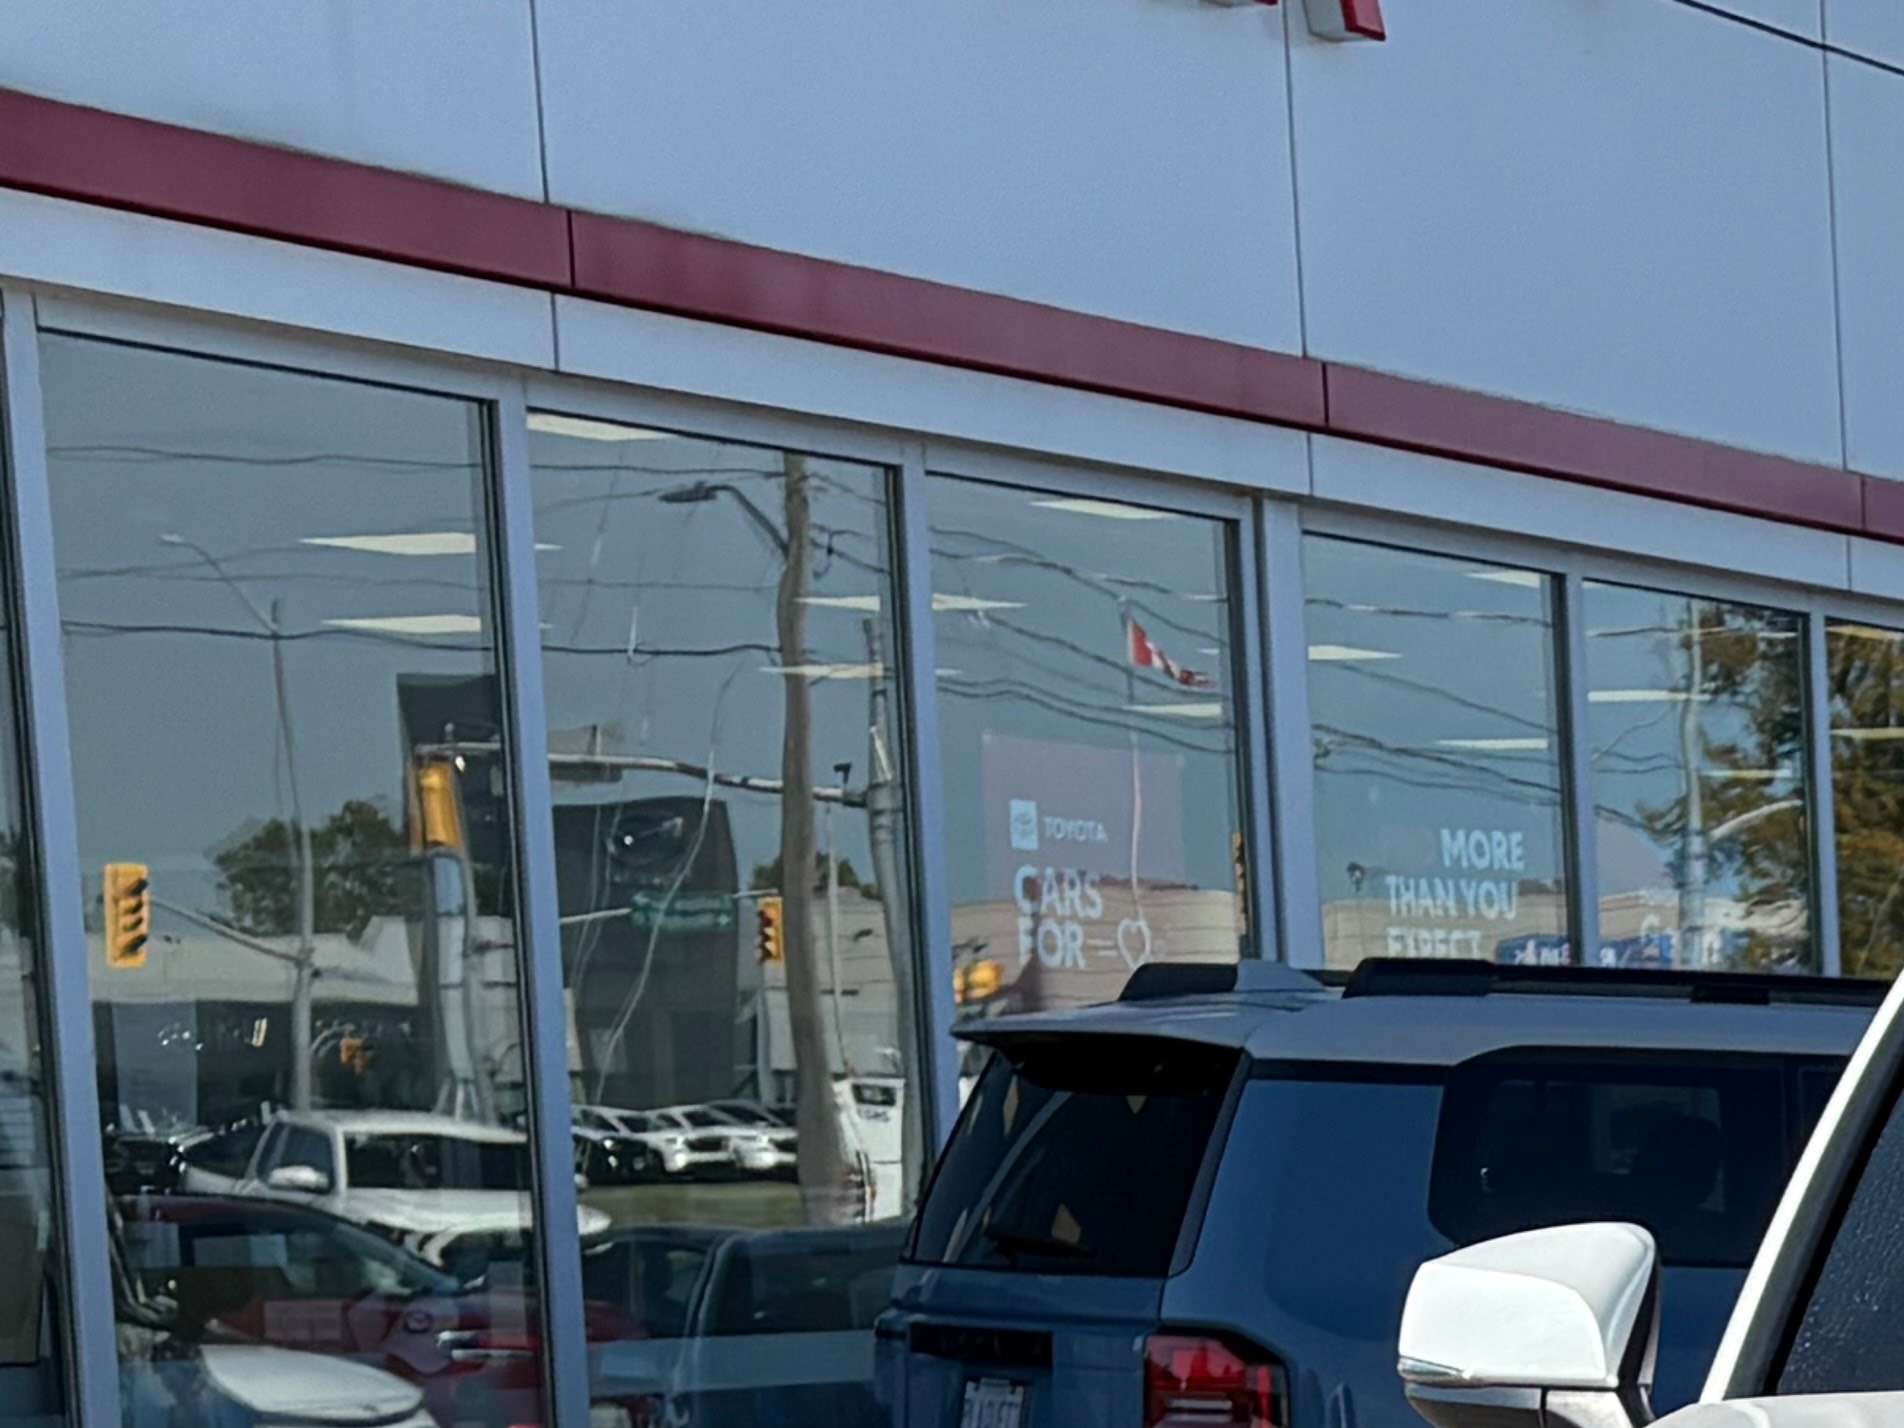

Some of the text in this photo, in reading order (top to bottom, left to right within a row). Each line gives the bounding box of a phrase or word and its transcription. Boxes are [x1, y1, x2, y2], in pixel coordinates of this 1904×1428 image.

[1043, 816, 1108, 843] TOYOTA
[1440, 828, 1526, 870] MORE
[1014, 865, 1105, 920] CARS
[1385, 874, 1518, 920] THAN YOU
[1018, 917, 1088, 970] FOR
